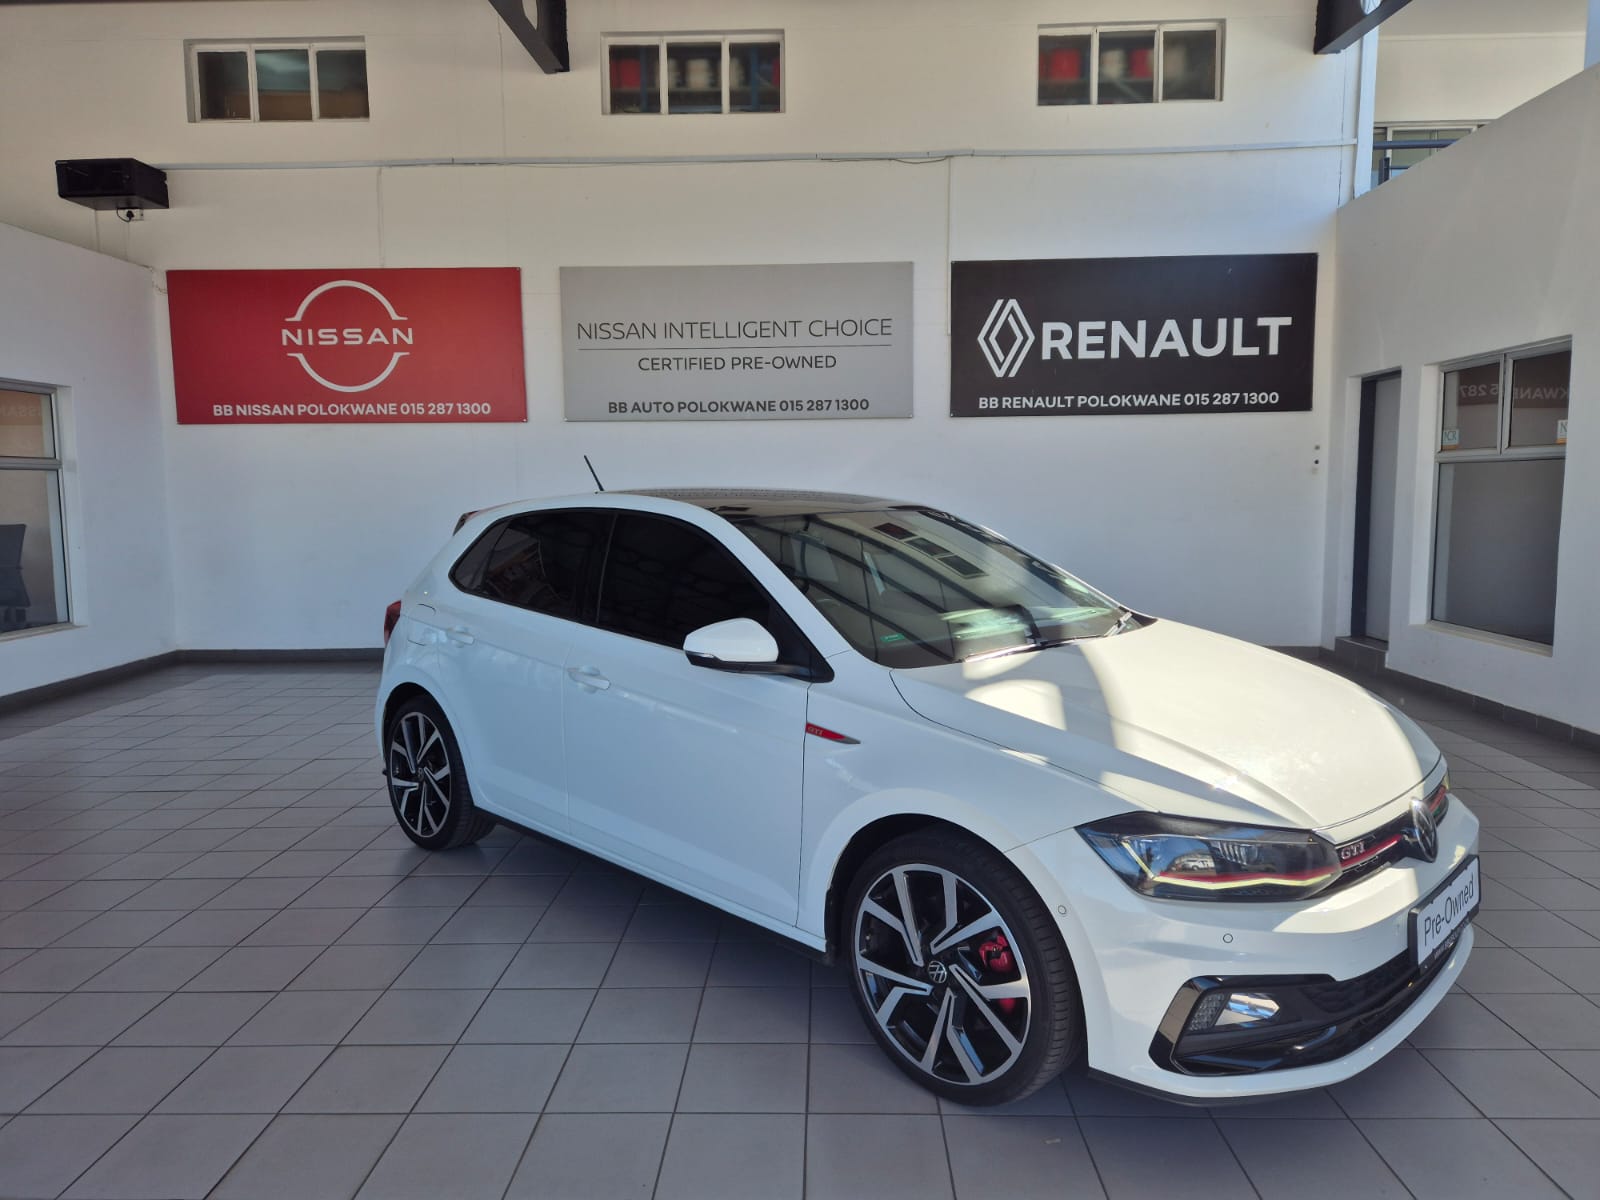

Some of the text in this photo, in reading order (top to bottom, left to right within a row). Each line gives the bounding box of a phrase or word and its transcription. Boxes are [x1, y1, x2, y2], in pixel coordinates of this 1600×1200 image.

[281, 327, 414, 346] NISSAN
[576, 317, 893, 341] NISSAN INTELLIGENT CHOICE
[1041, 316, 1293, 361] RENAULT
[637, 354, 837, 372] CERTIFIED PRE-OWNED
[212, 402, 492, 417] BB NISSAN POLOKWANE 015 287 1300
[607, 398, 870, 414] BB AUTO POLOKWANE 015 287 1300
[978, 391, 1280, 409] BB RENAULT POLOKWANE 015 287 1300
[1341, 841, 1366, 860] GTI
[1424, 877, 1475, 947] Pre-Owned
